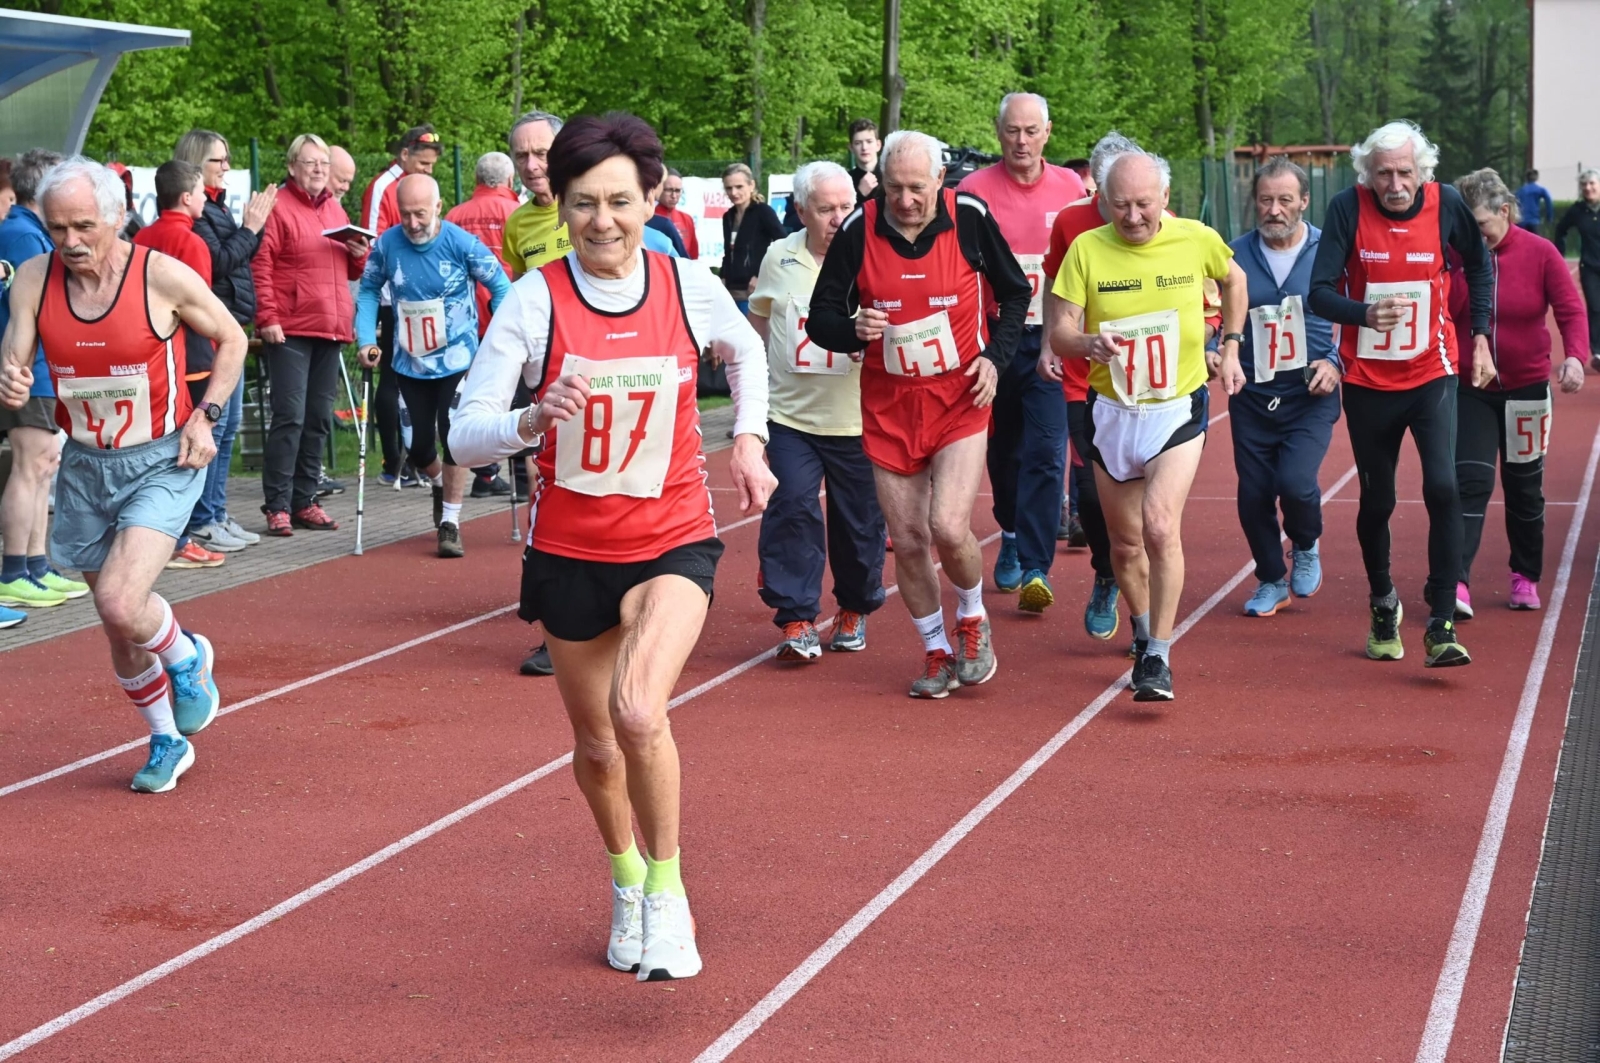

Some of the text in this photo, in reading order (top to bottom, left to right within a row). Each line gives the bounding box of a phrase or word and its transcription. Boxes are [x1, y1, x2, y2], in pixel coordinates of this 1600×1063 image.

[1098, 279, 1142, 288] MARATON
[1156, 274, 1194, 287] Krakonoš
[405, 316, 437, 352] 10
[889, 325, 941, 345] PIVOVAR TRUTNOV
[1141, 324, 1169, 336] TRUTNOV
[1264, 315, 1295, 369] 75
[110, 362, 147, 373] MARATON
[897, 338, 946, 377] 43
[1118, 335, 1167, 396] 70
[578, 374, 614, 389] OVAR
[617, 373, 662, 388] TRUTNOV
[72, 388, 137, 400] PIVOVAR TRUTNOV
[82, 399, 134, 449] 42
[581, 391, 656, 474] 87
